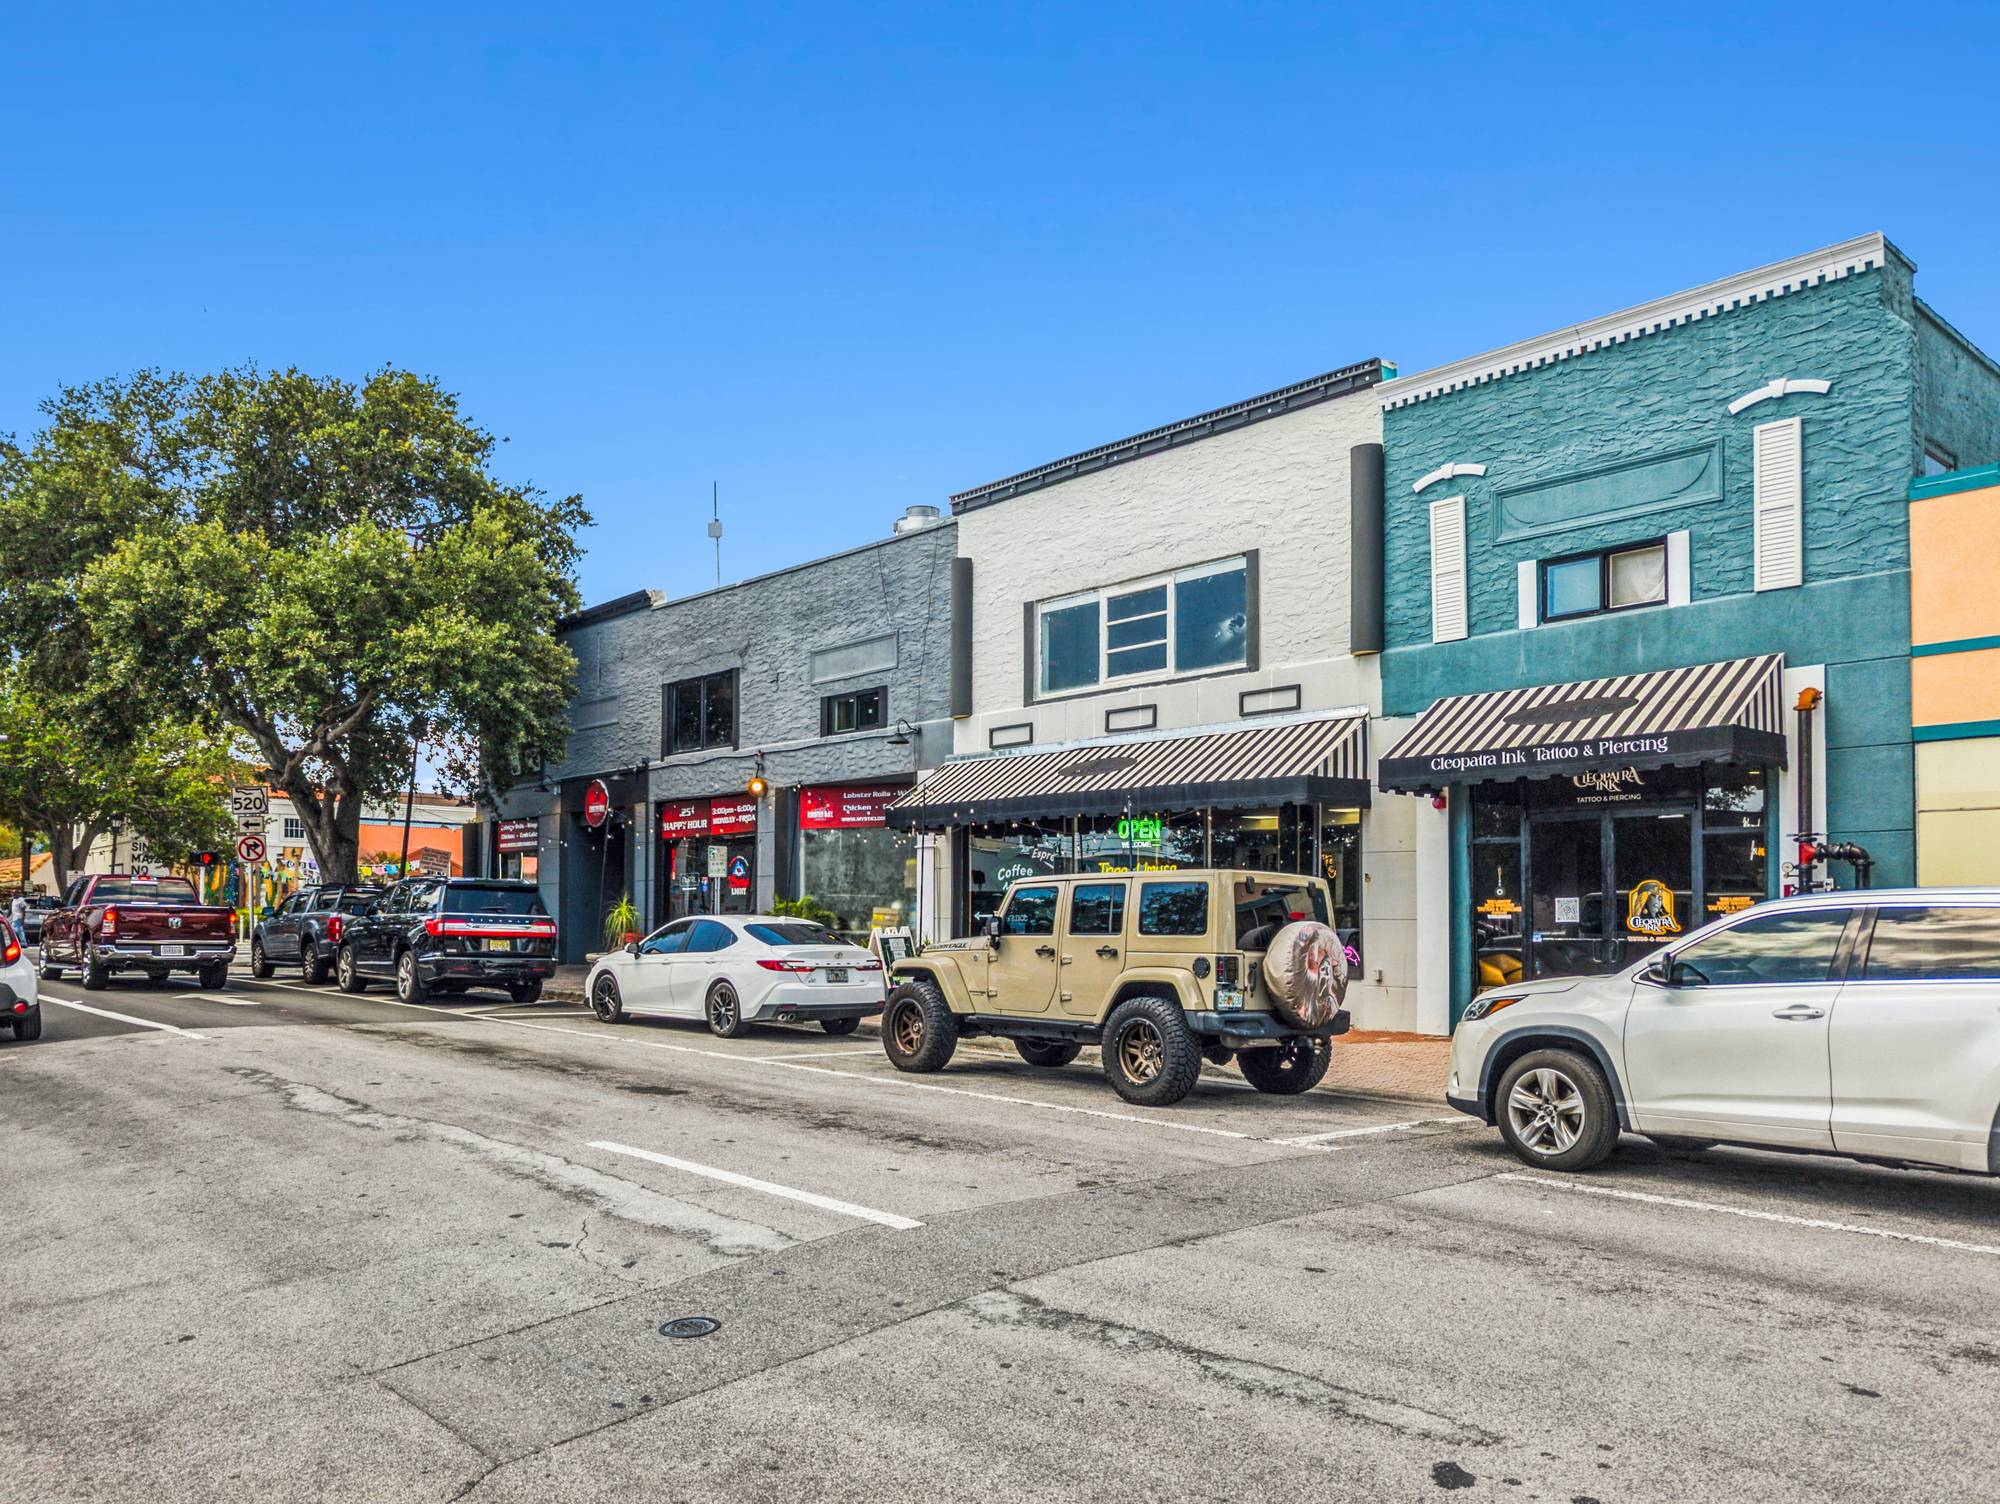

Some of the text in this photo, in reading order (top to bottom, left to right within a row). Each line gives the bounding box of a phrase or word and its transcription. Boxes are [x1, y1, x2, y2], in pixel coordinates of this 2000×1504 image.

[1430, 737, 1668, 771] Cleopatra Ink Tattoo & Piercing
[1596, 780, 1621, 792] INK
[873, 790, 891, 798] Rolls
[1609, 793, 1642, 802] PIERCING
[233, 797, 263, 811] 520
[712, 807, 734, 815] 3:00pm
[663, 819, 707, 831] HAPPY HOUR
[713, 815, 736, 824] MONDAY
[1118, 820, 1162, 839] OPEN
[998, 864, 1034, 880] Coffee
[1630, 915, 1678, 930] CLEOPATRA
